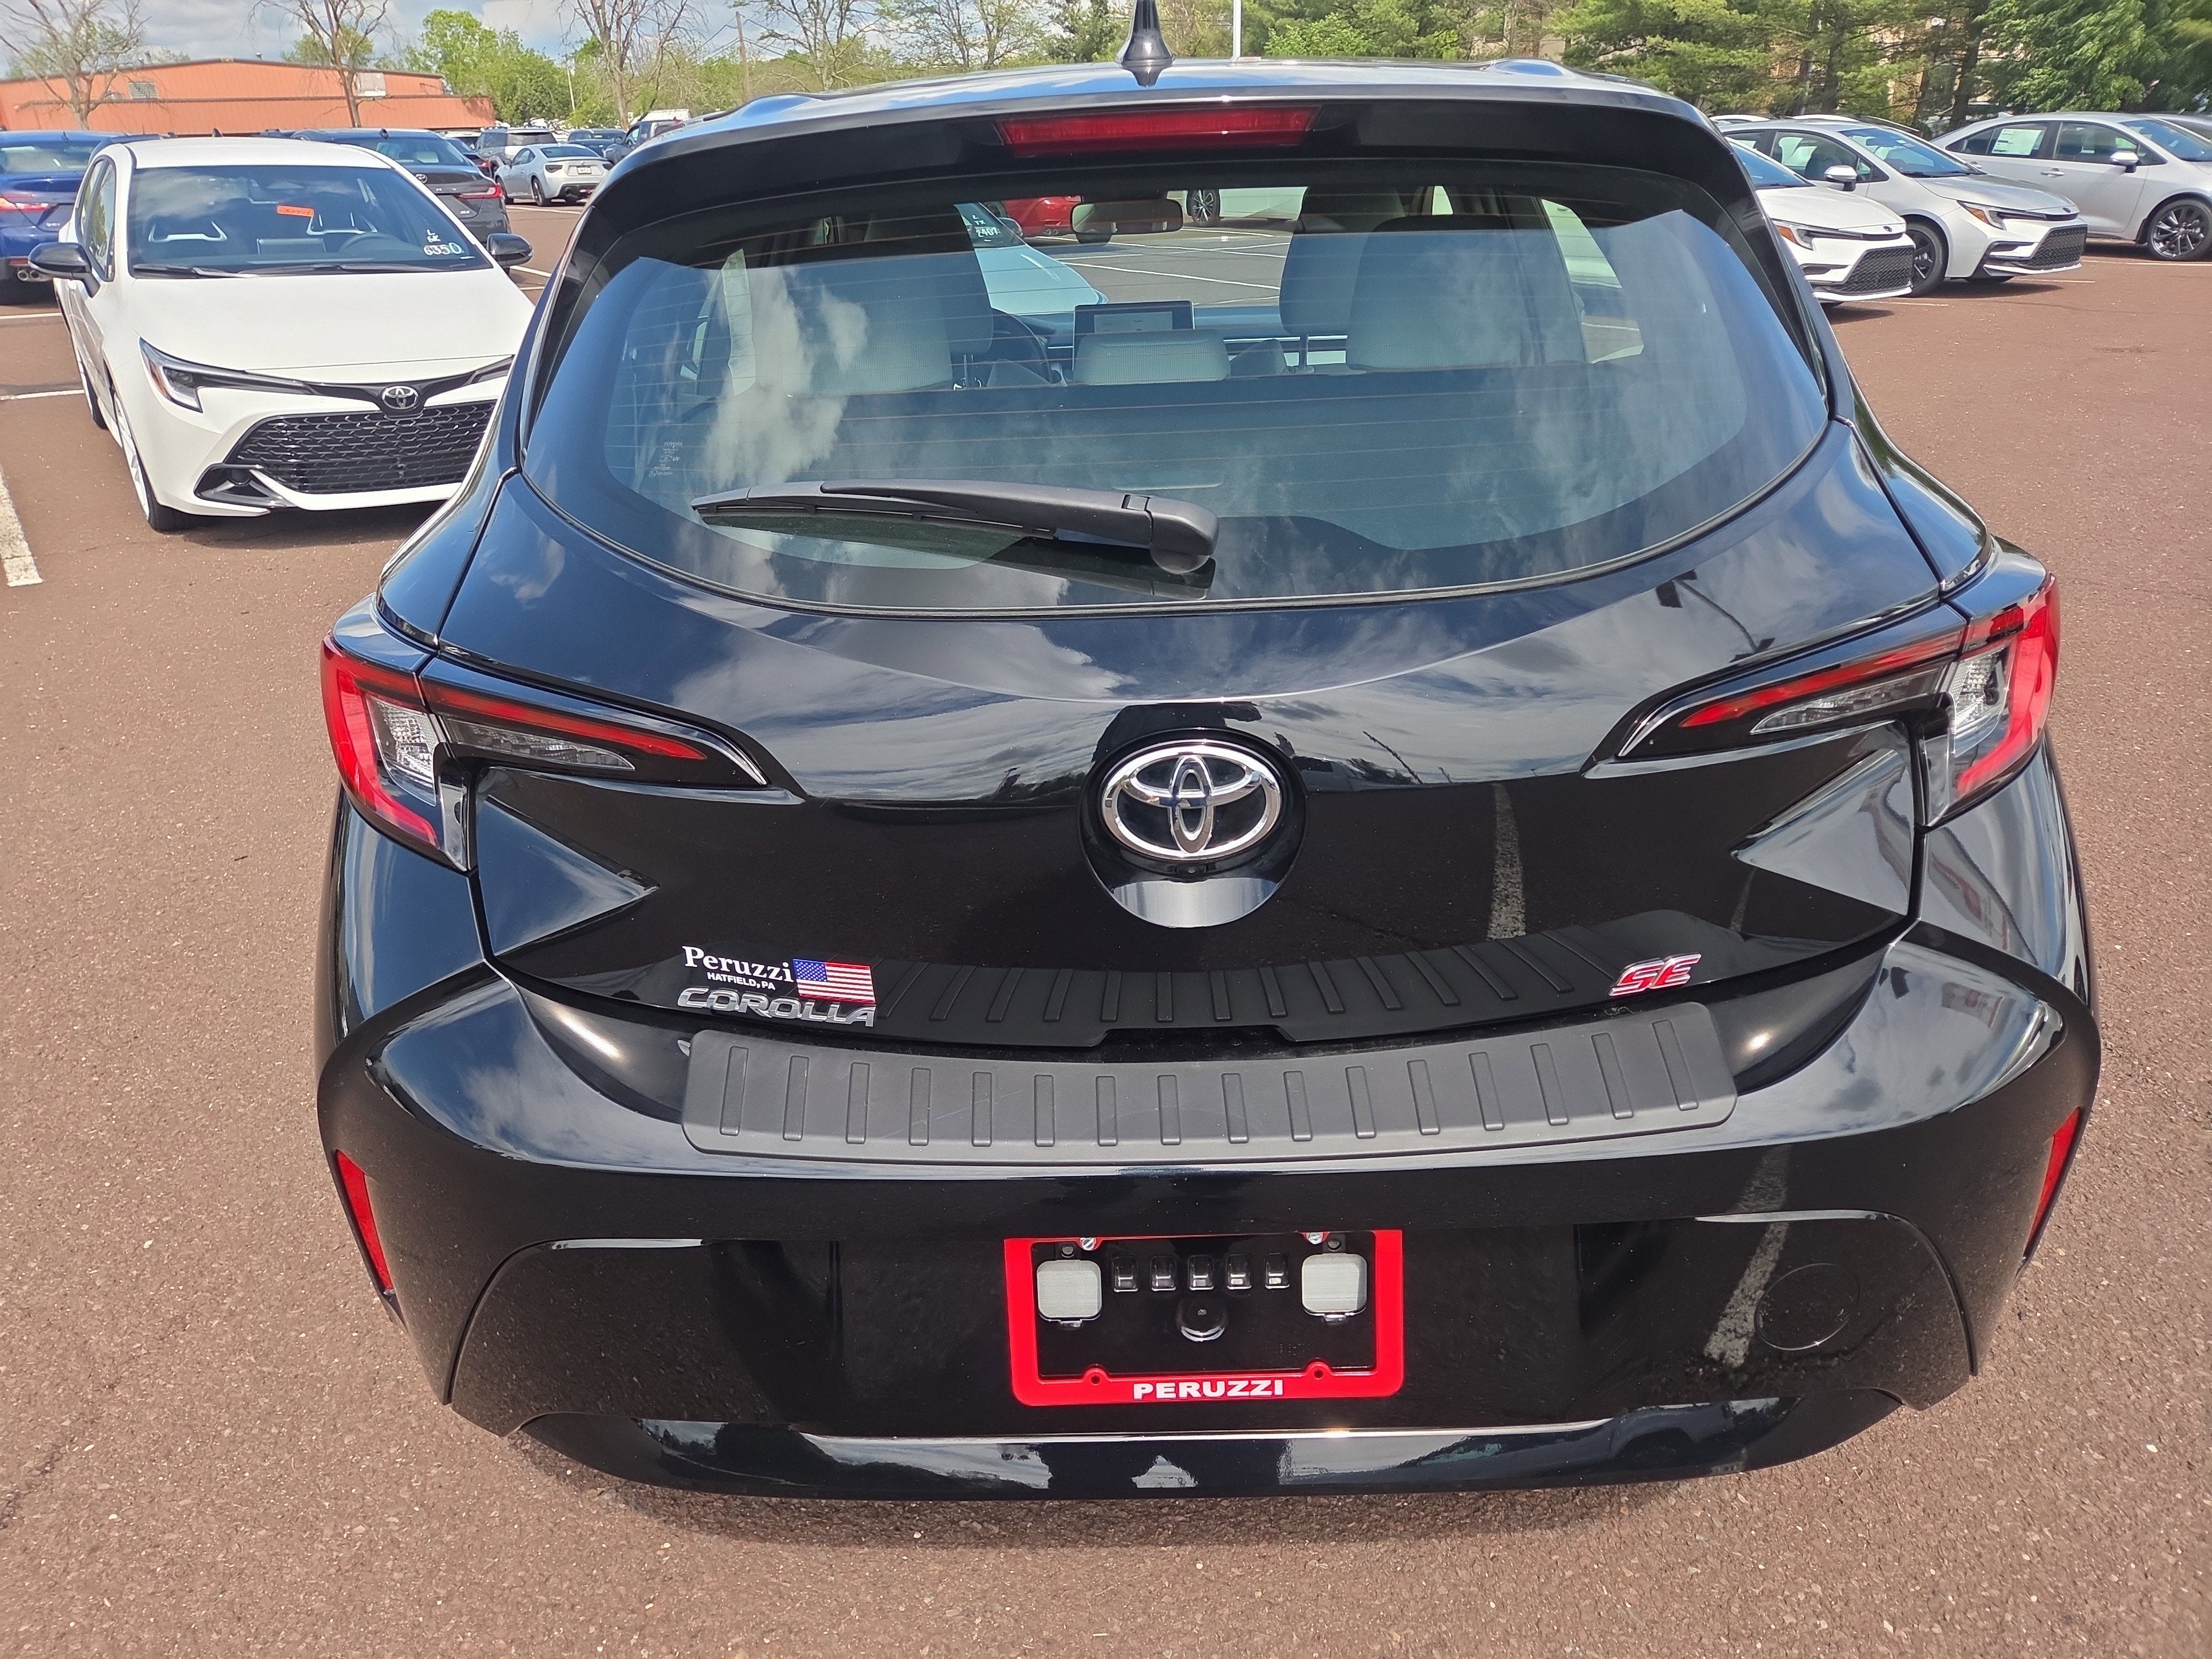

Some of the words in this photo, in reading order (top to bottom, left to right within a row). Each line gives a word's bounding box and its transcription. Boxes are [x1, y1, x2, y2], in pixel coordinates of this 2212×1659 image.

[681, 945, 794, 983] Peruzzi
[1607, 953, 1702, 996] SE
[677, 986, 876, 1027] COROLLA
[1133, 1379, 1284, 1399] PERUZZI
